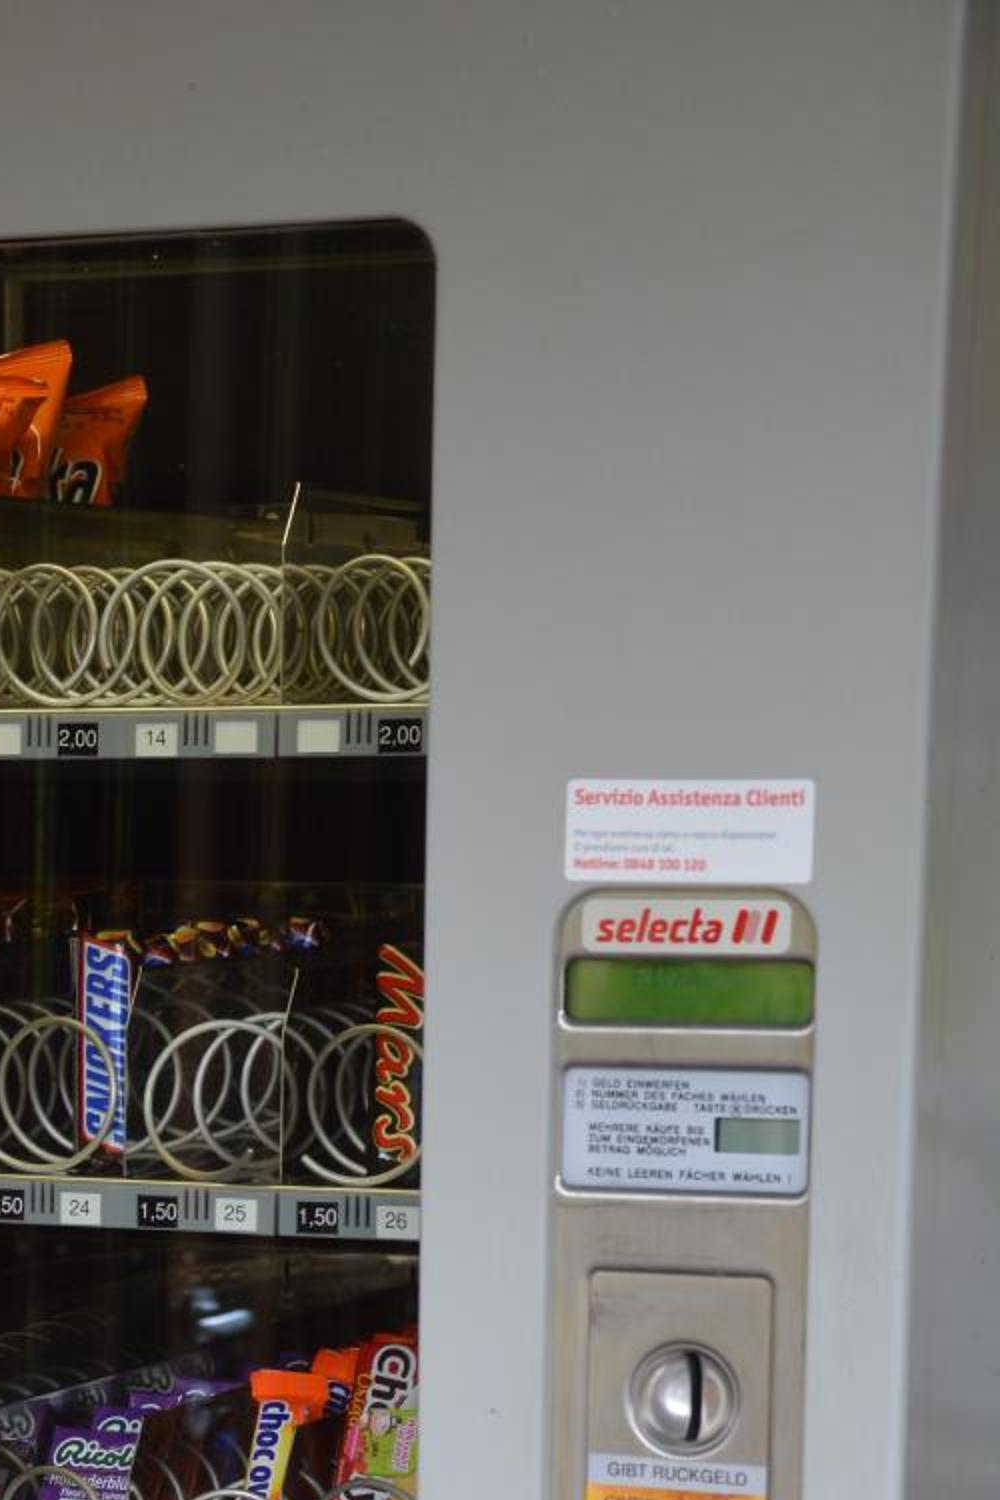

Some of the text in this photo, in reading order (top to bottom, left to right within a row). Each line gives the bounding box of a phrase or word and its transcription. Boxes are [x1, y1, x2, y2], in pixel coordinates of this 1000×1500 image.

[59, 729, 97, 751] 2,00
[144, 728, 168, 747] 14
[379, 725, 421, 746] 2,00
[574, 788, 806, 807] Servizio Assistenza Clienti
[595, 907, 724, 944] selecta
[85, 945, 129, 1146] SNICKERS
[375, 943, 424, 1163] Mars
[627, 1079, 690, 1090] EINWERFEN
[587, 1166, 621, 1177] KEINE
[628, 1168, 673, 1179] LEEREN
[68, 1199, 90, 1216] 24
[140, 1203, 178, 1222] 1,50
[223, 1204, 247, 1222] 25
[299, 1206, 337, 1227] 1,50
[385, 1212, 407, 1230] 26
[252, 1400, 291, 1462] choc
[53, 1437, 136, 1470] Ricol
[607, 1461, 647, 1478] GIBT
